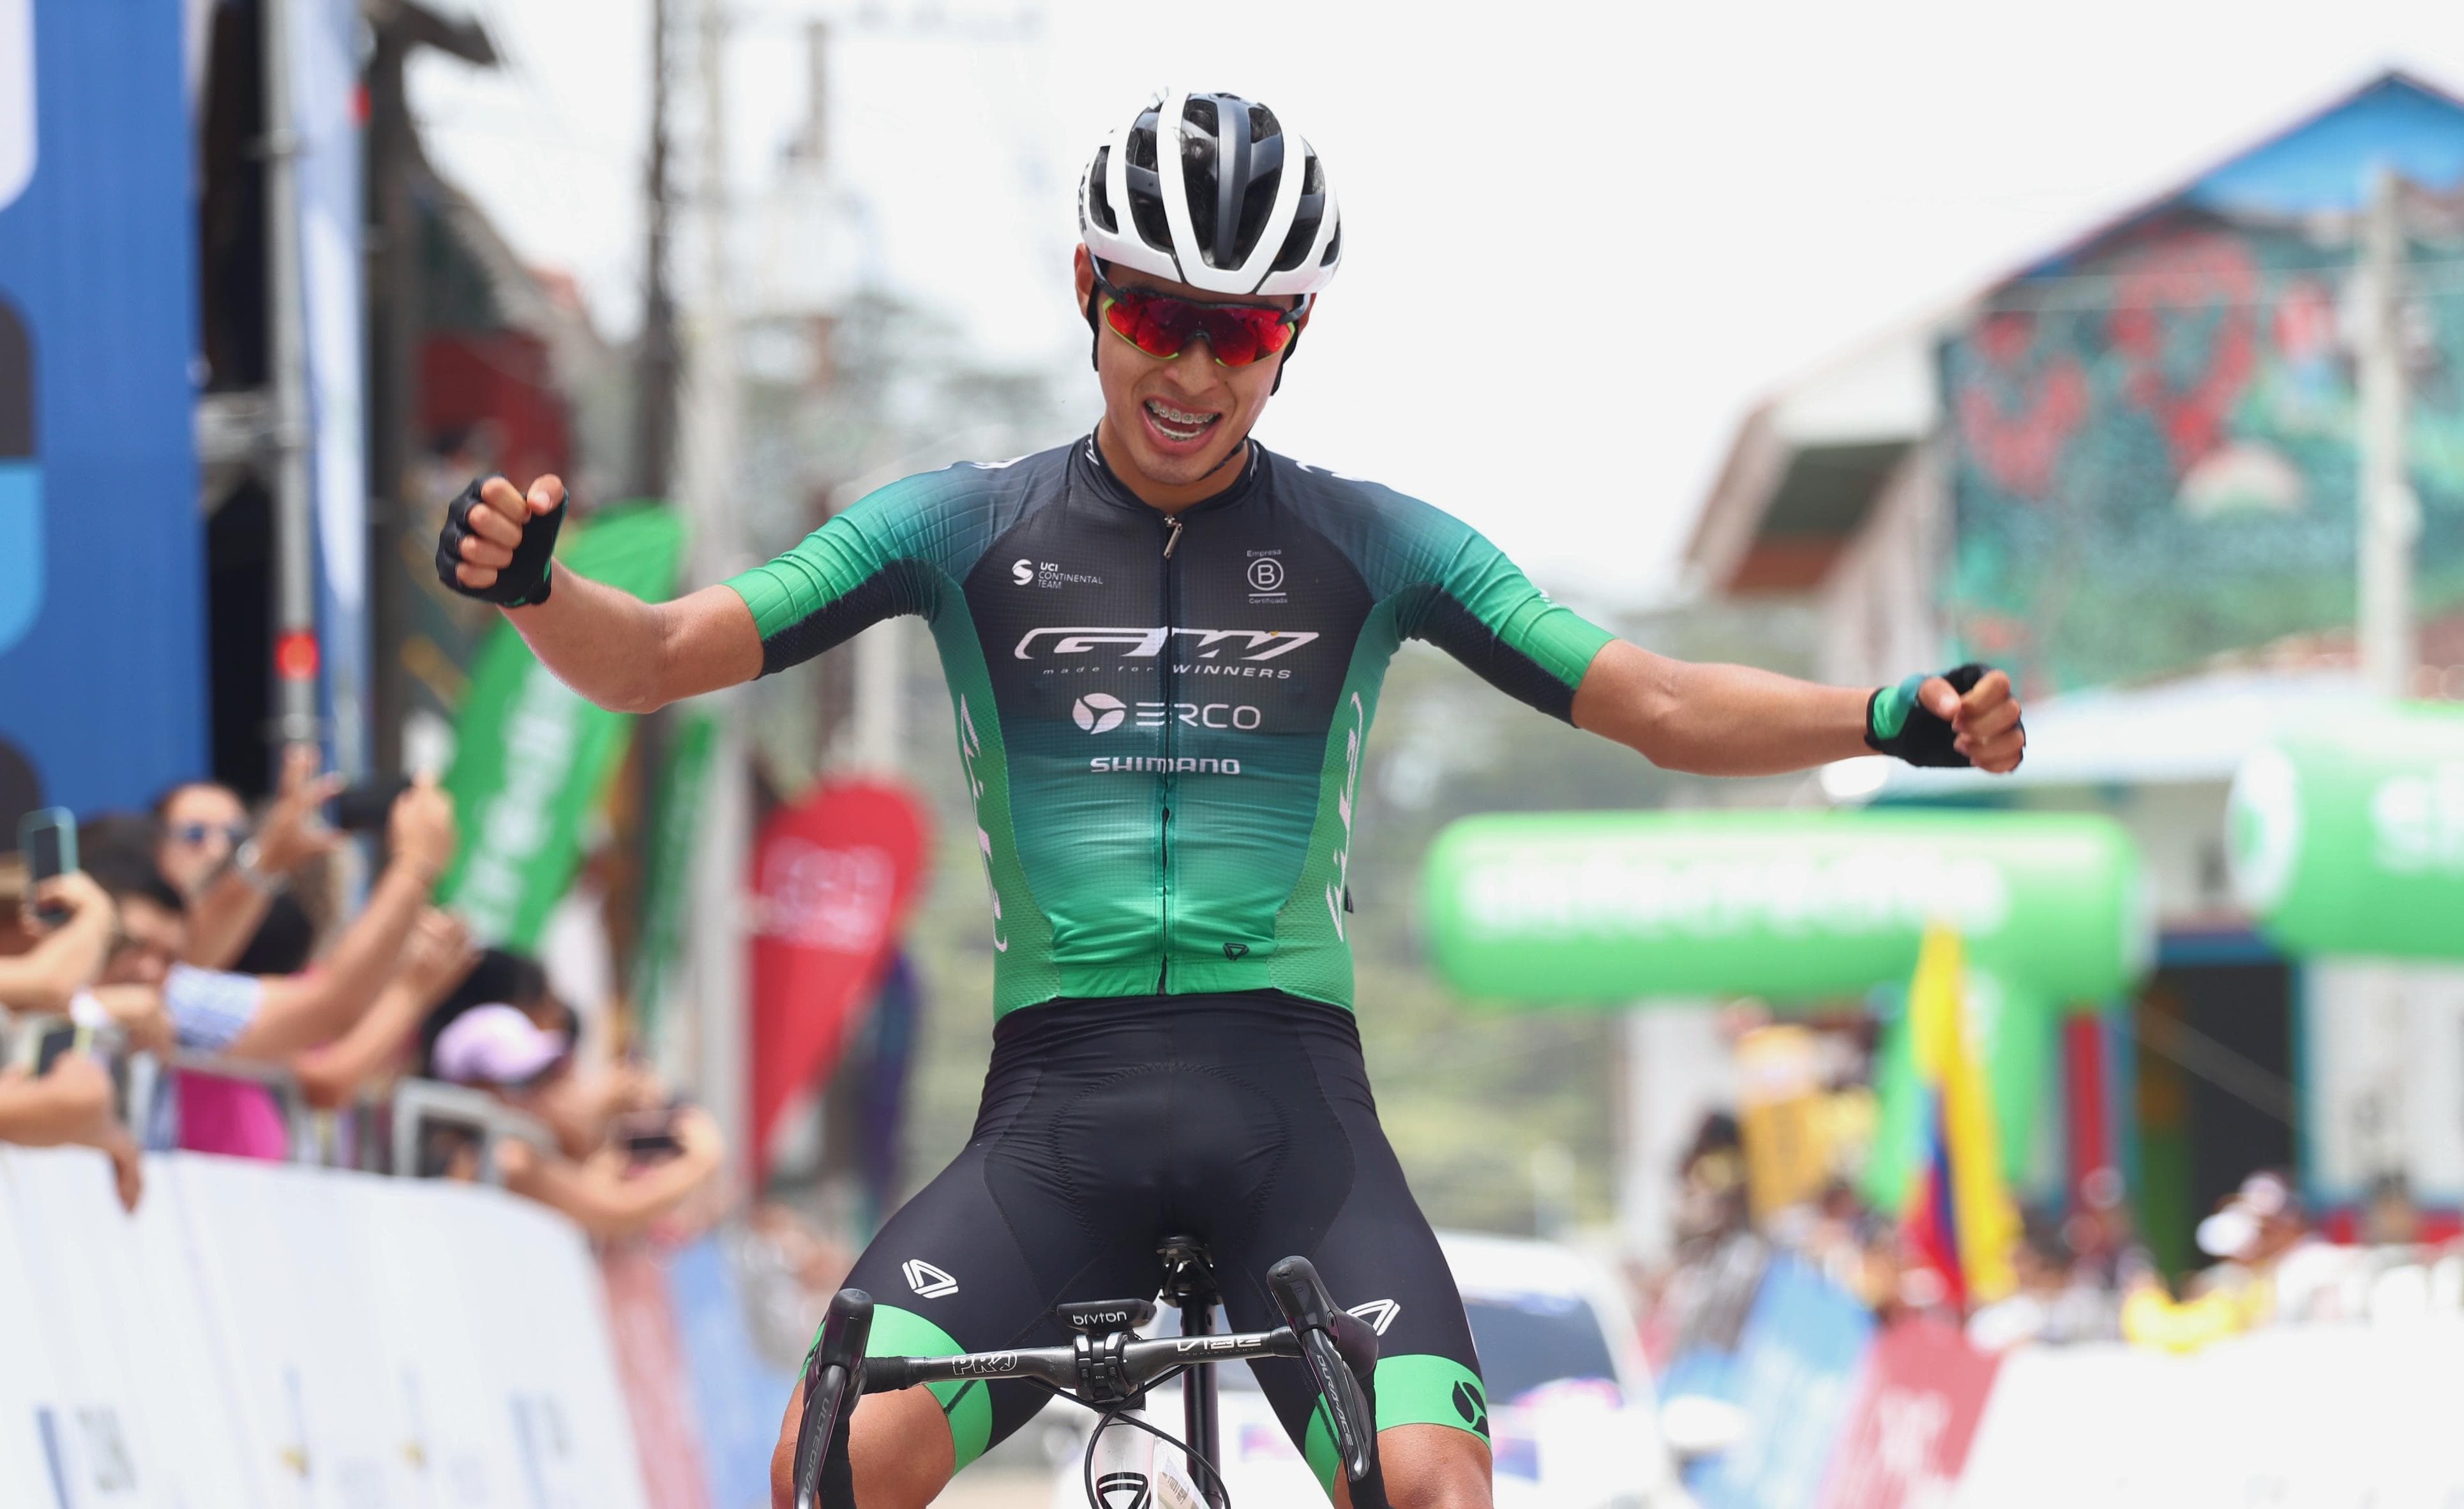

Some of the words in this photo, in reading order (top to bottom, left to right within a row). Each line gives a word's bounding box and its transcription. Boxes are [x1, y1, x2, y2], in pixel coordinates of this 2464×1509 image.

[1040, 562, 1058, 571] UCI
[1258, 564, 1275, 584] B
[1038, 571, 1103, 585] CONTINENTAL
[1038, 579, 1062, 589] TEAM
[1043, 665, 1100, 675] made
[1173, 663, 1292, 679] WINNERS
[1136, 702, 1261, 730] ERCO
[1090, 756, 1240, 774] SHIMANO
[1072, 1310, 1127, 1325] bryton
[1176, 1337, 1261, 1352] VIBE
[952, 1351, 1018, 1376] PRO
[1316, 1354, 1354, 1446] DURA-ACE
[804, 1397, 829, 1494] ULTEGRA
